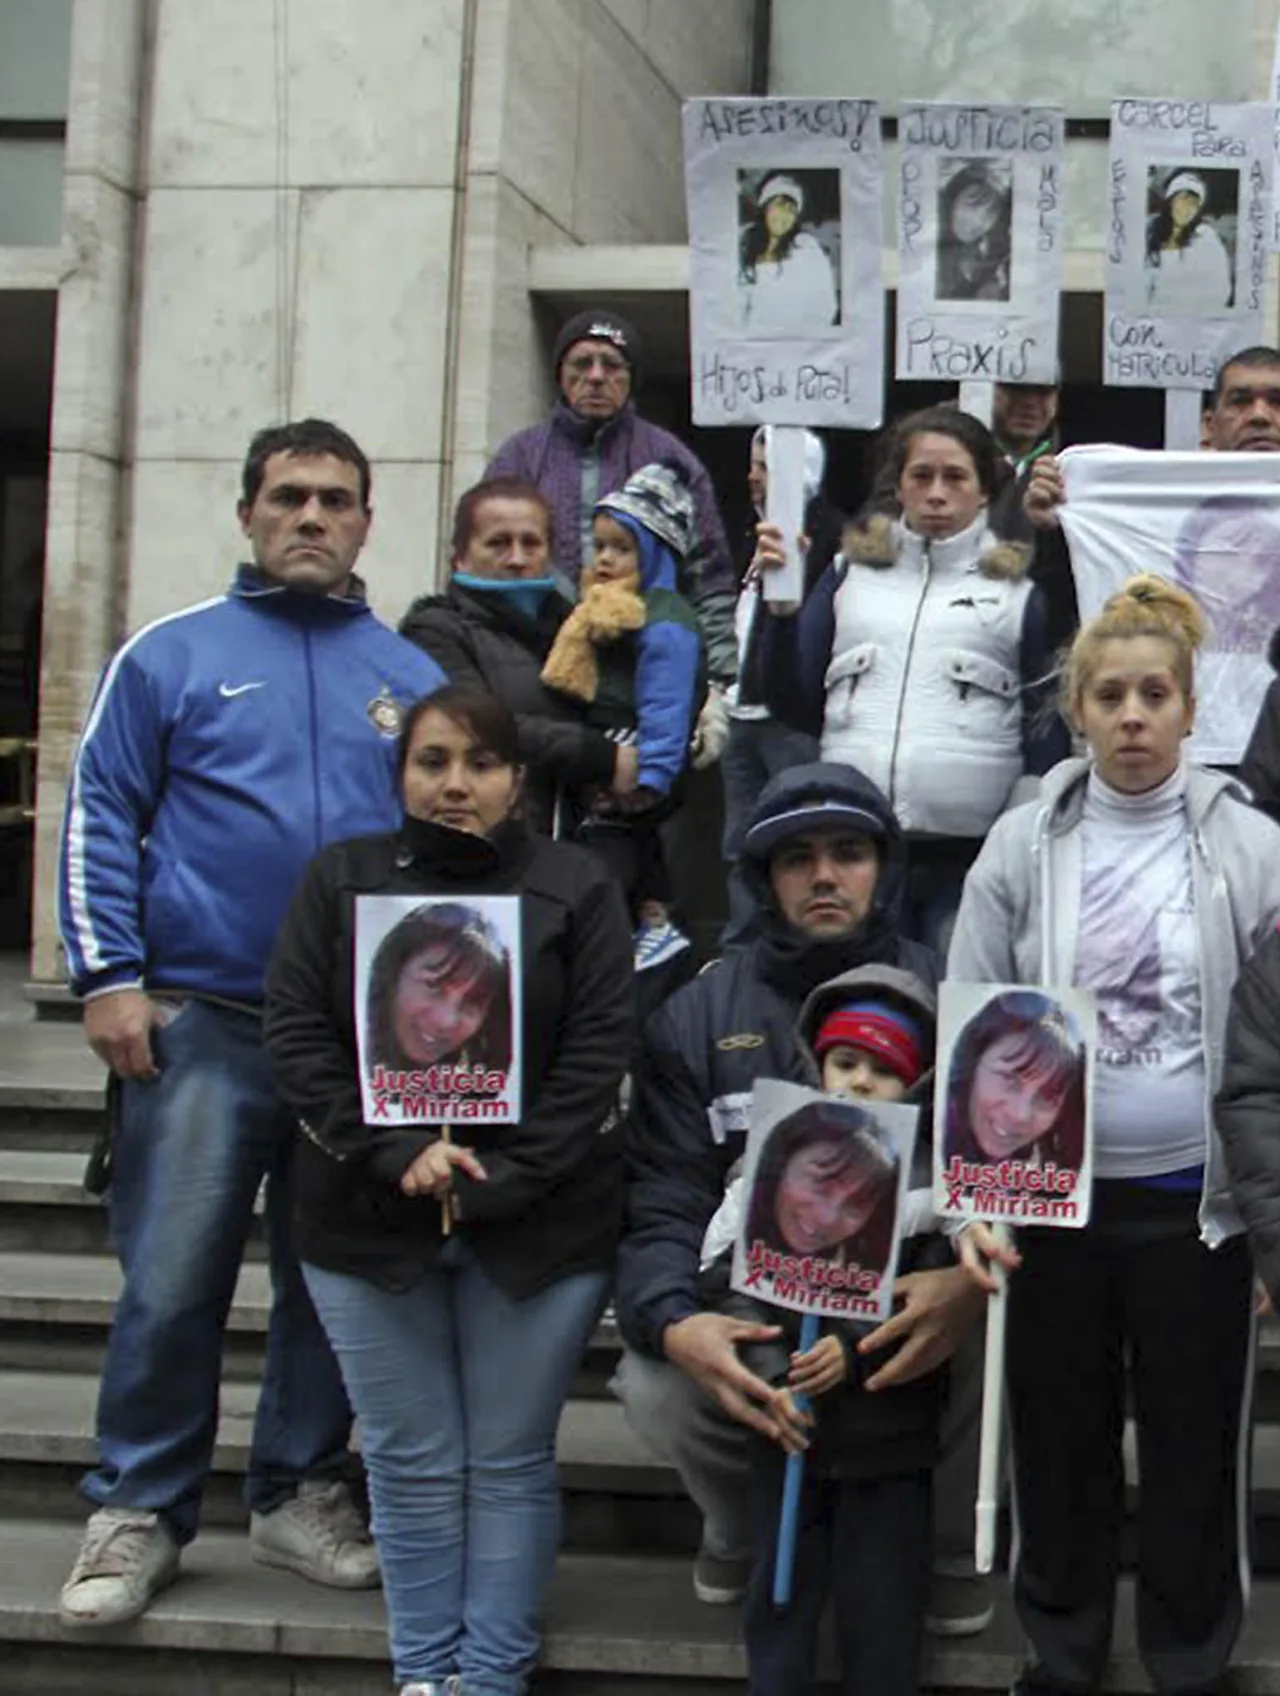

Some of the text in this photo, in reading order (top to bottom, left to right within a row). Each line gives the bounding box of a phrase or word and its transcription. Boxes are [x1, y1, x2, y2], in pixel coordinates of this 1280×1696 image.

[370, 1064, 507, 1093] Justicia
[372, 1095, 510, 1118] X Miriam
[942, 1155, 1078, 1193] Justicia
[944, 1188, 1079, 1218] X Miriam
[745, 1239, 881, 1292] Justicia
[772, 1277, 881, 1315] Miriam
